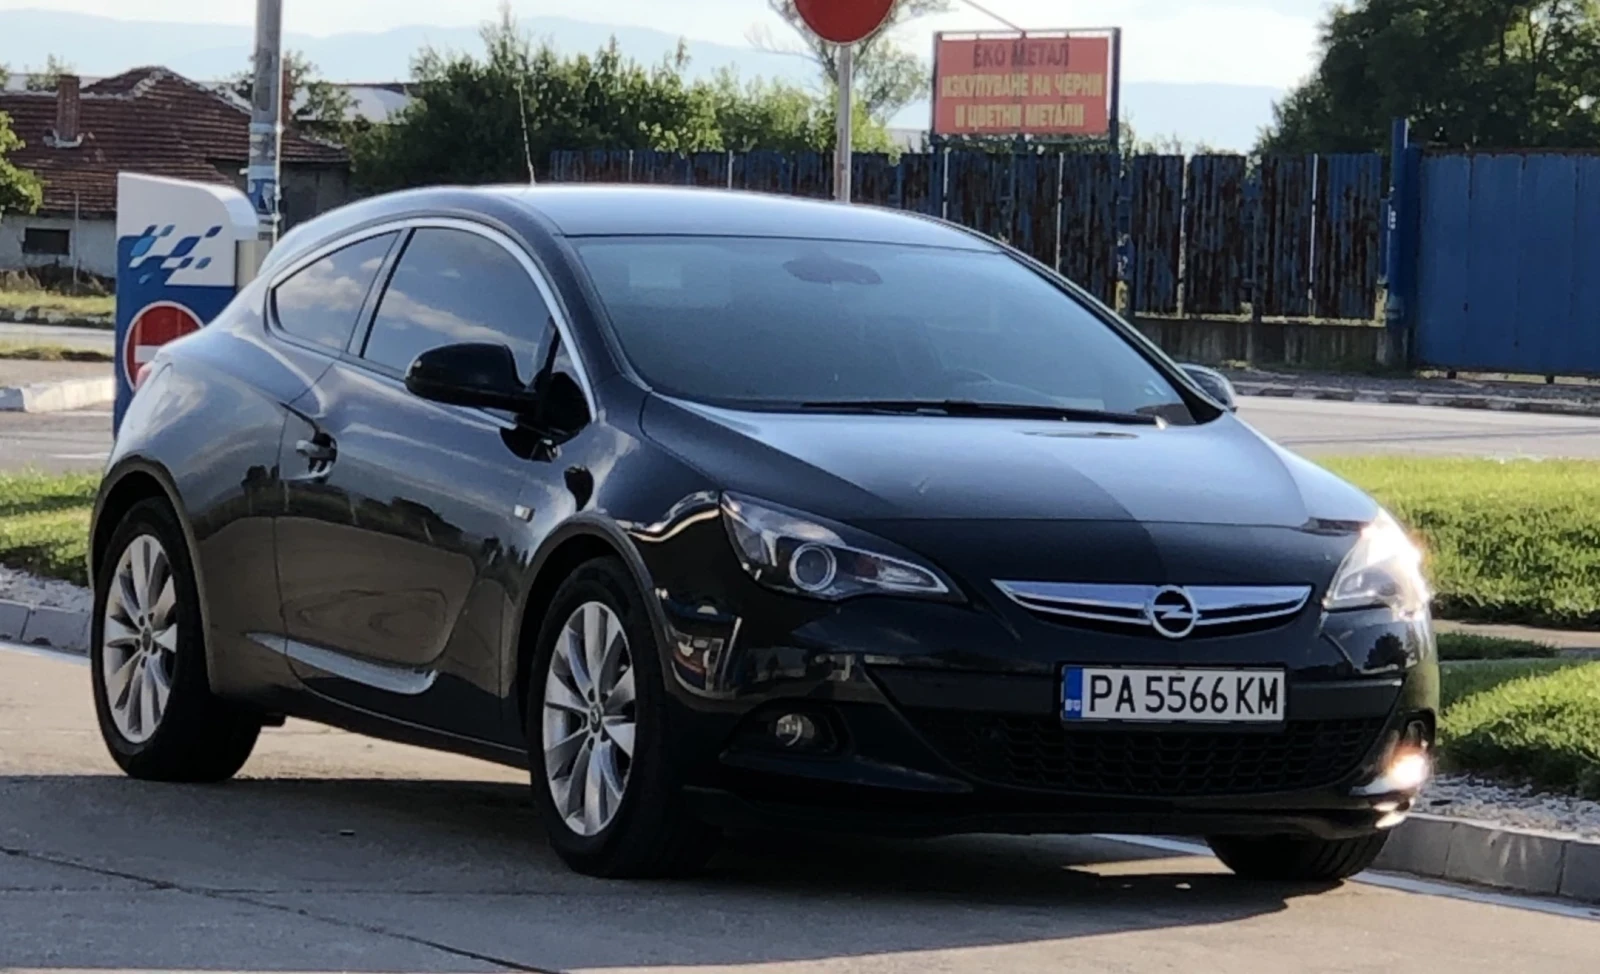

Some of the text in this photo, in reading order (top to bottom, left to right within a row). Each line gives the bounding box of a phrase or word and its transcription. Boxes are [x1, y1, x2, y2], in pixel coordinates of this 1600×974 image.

[973, 42, 1069, 69] ЕКО МЕТАЛ
[942, 73, 1103, 97] ИЗКУПУВАНЕ НА ЧЕРНИ
[955, 103, 1084, 131] И ЦВЕТНИ МЕТАЛИ
[1089, 675, 1279, 714] PA 5566 KM
